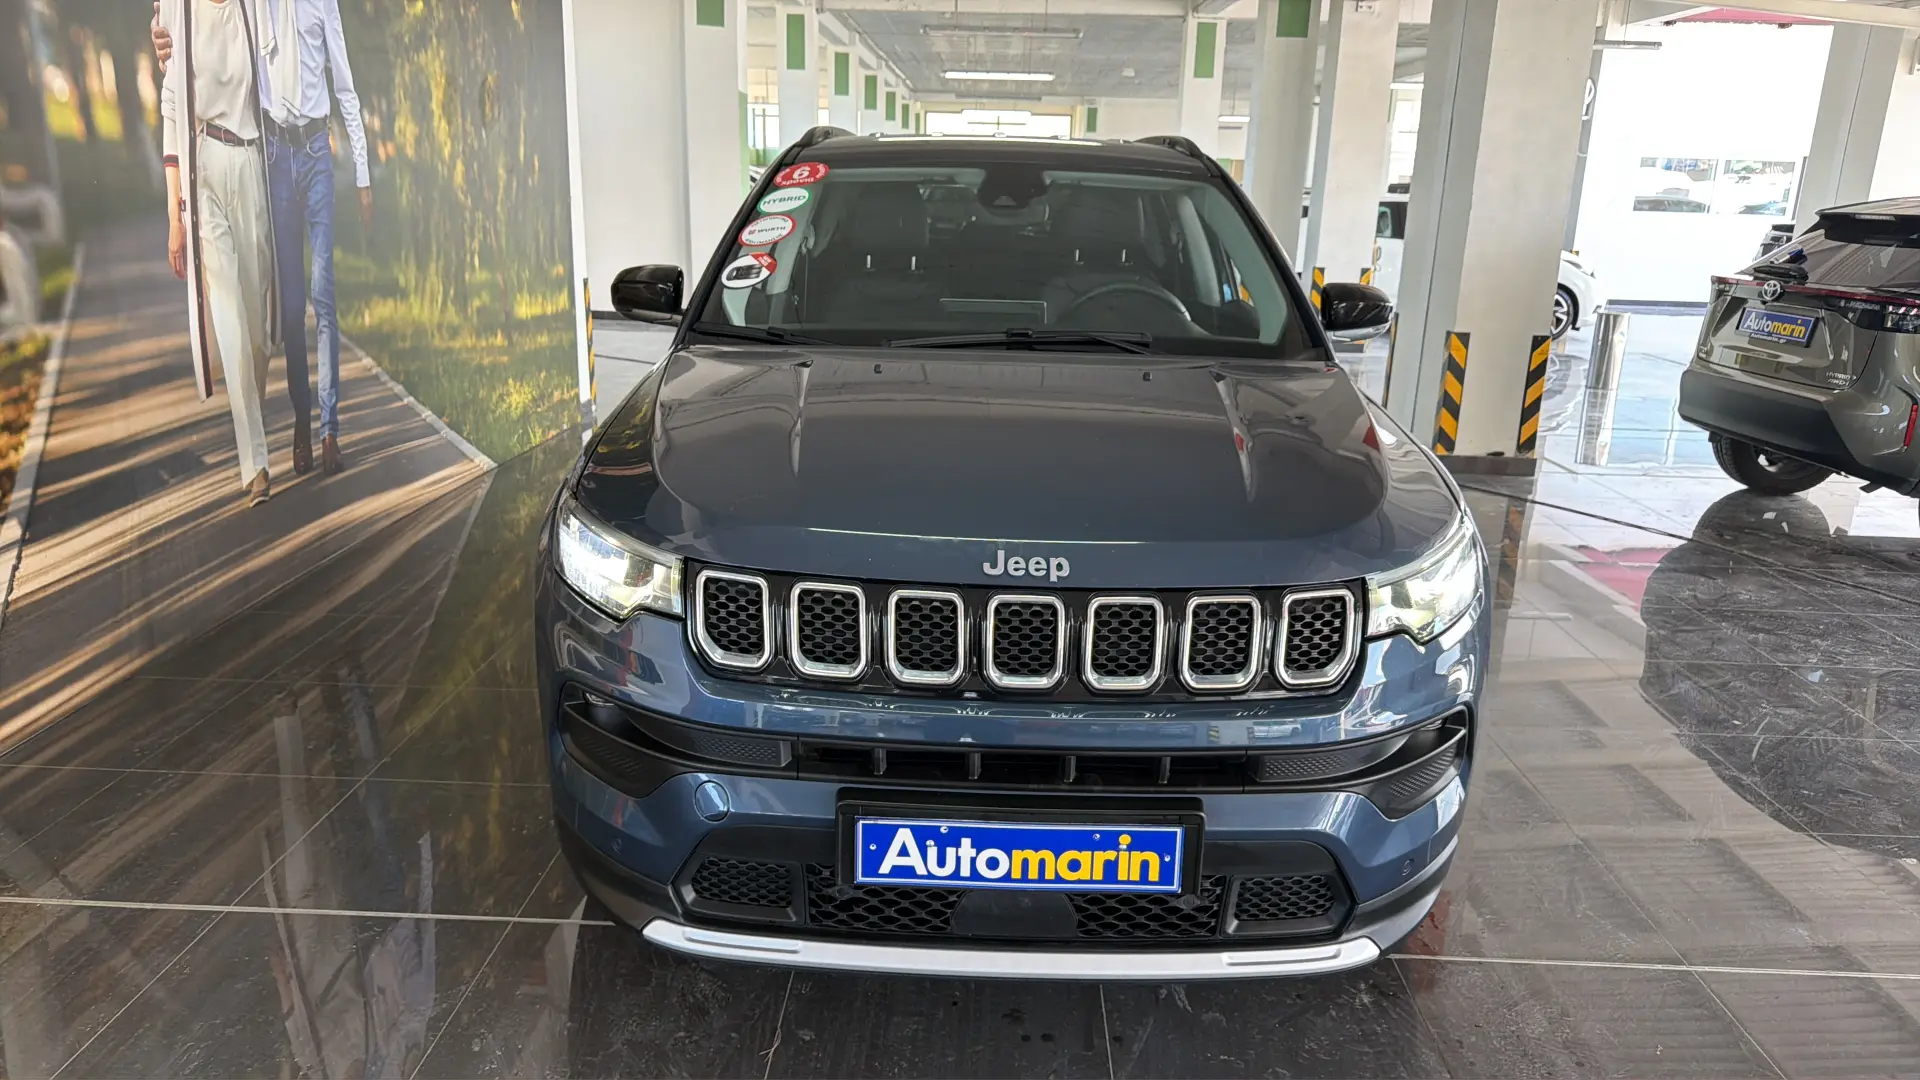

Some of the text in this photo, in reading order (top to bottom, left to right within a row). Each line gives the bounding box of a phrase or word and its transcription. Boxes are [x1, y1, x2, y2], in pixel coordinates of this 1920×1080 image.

[792, 166, 811, 179] 6
[762, 195, 806, 206] HYBRID
[1743, 311, 1806, 338] Automarin
[982, 549, 1070, 583] Jeep
[877, 827, 1160, 882] Automarin
